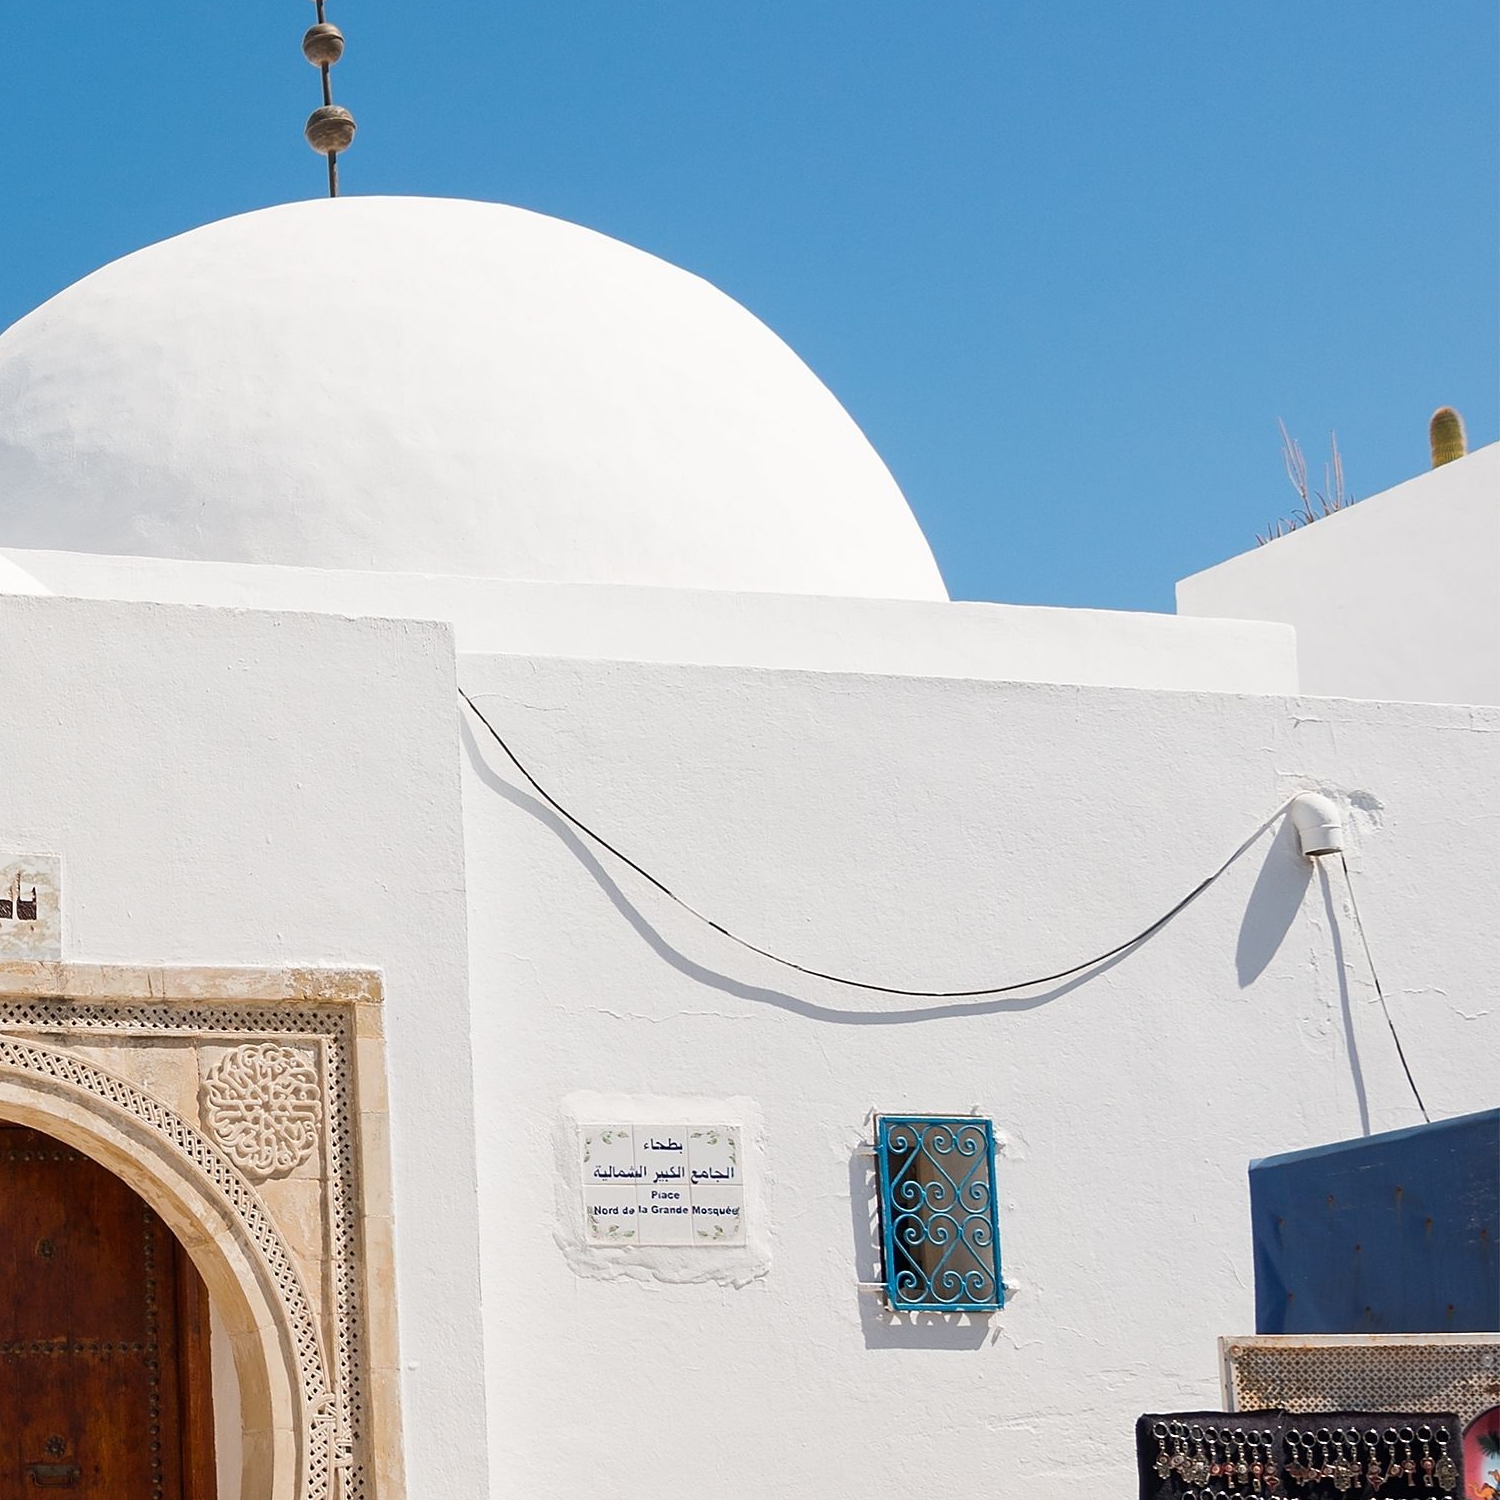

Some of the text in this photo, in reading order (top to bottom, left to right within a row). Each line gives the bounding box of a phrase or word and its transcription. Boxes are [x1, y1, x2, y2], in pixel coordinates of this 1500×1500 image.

[643, 1138, 683, 1154] بطحاء
[593, 1165, 734, 1185] الجامع الكبير الشمالية
[651, 1190, 681, 1200] Place
[594, 1205, 740, 1217] Nord de la Grande Mosquée
